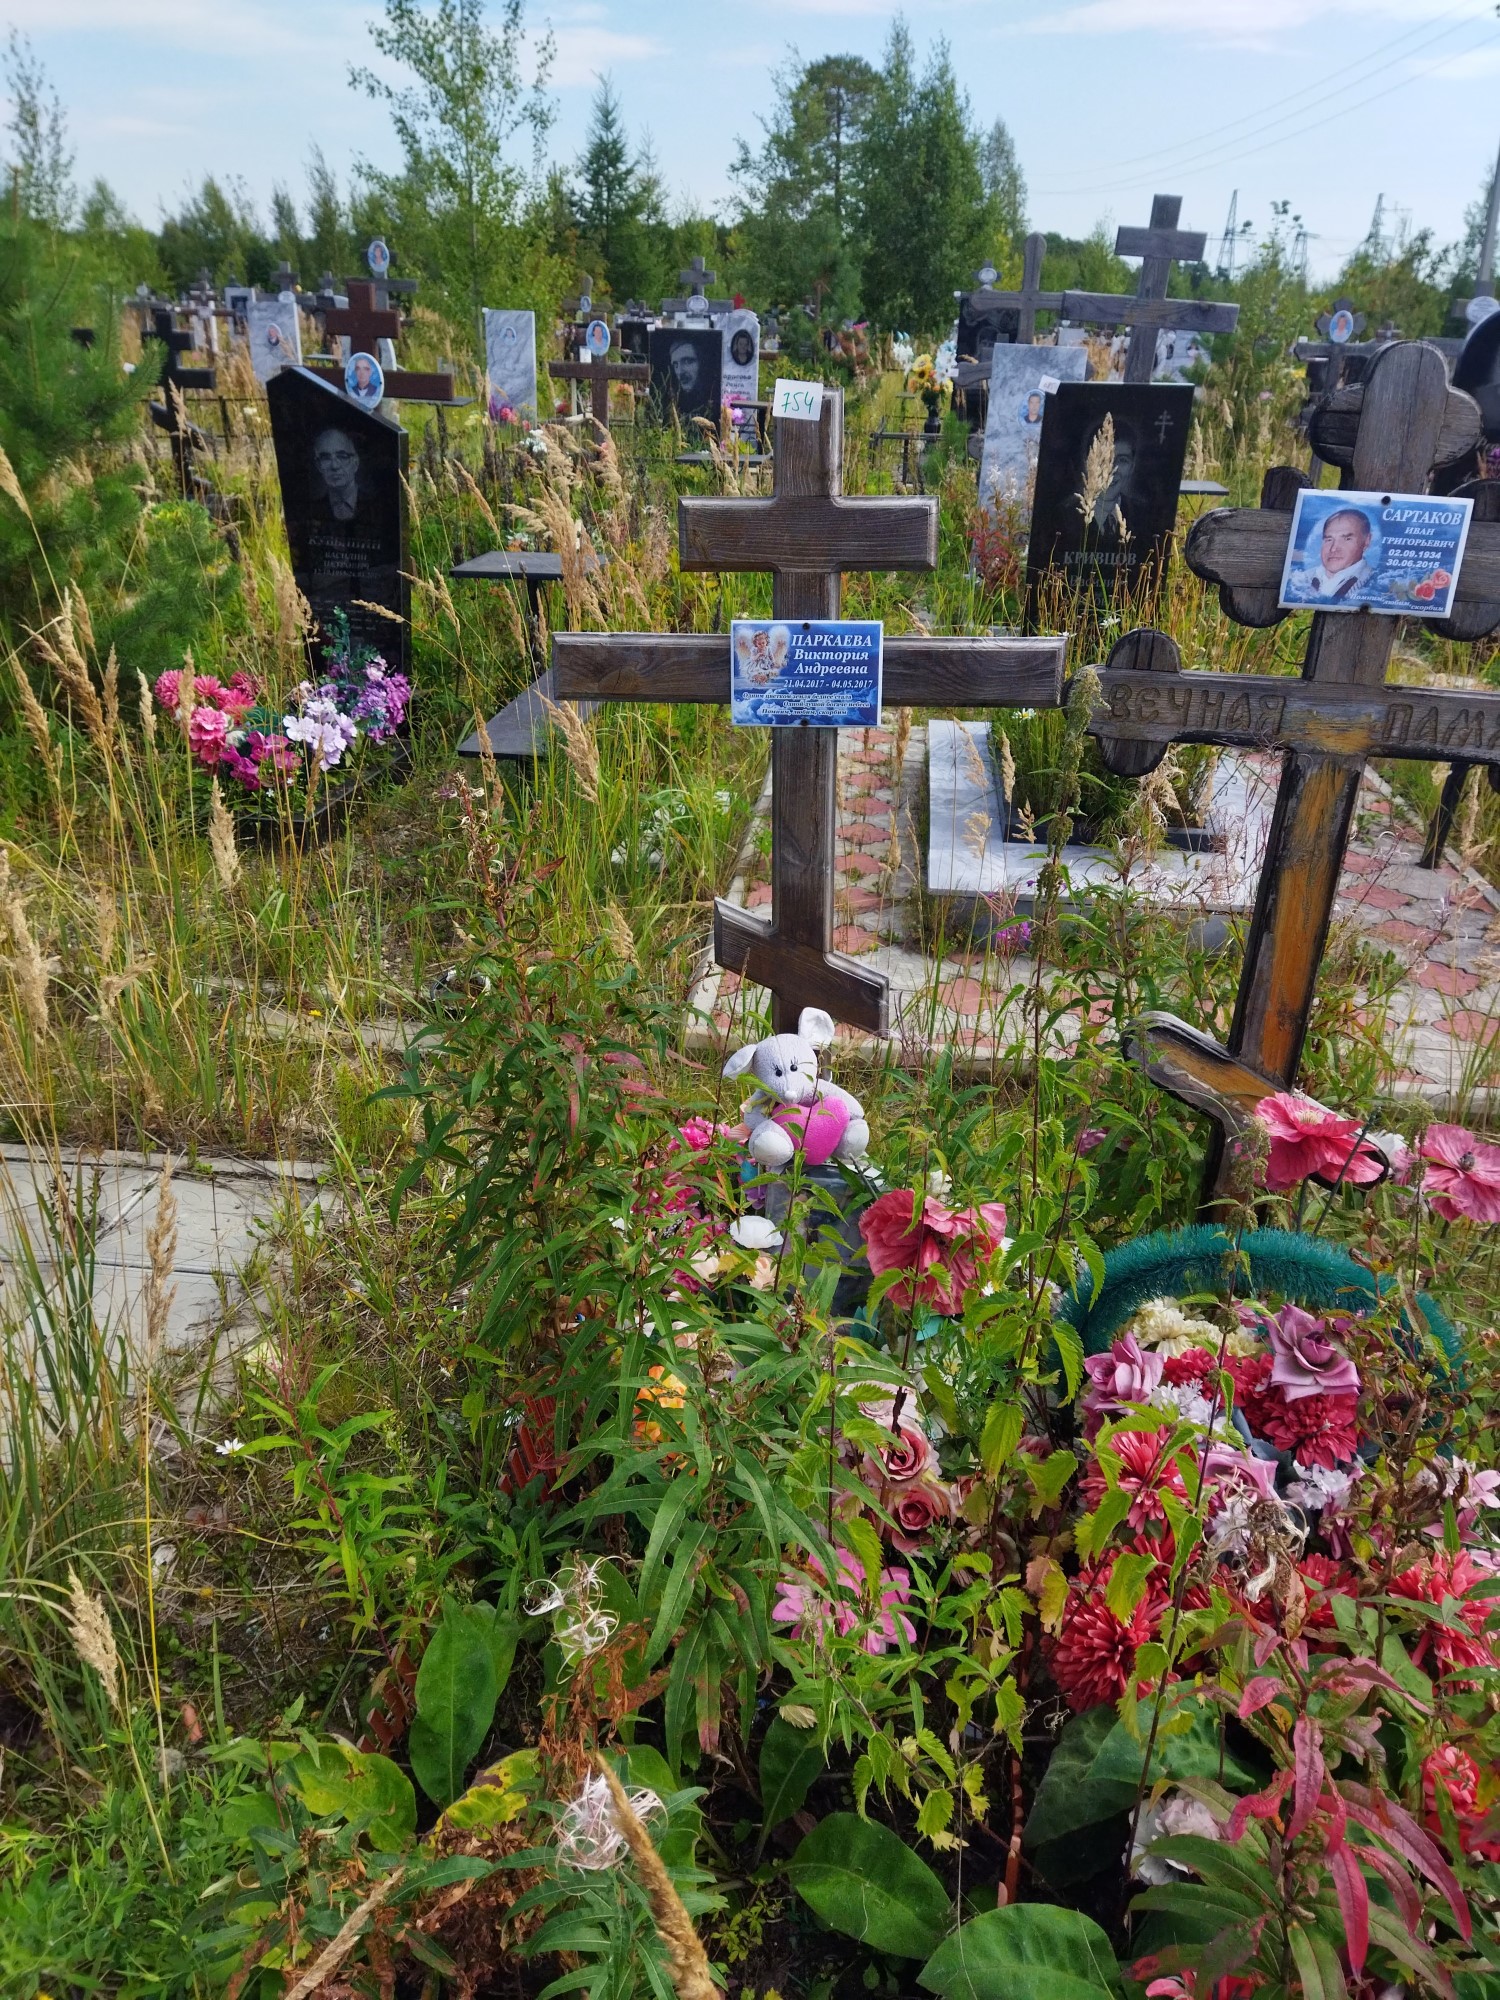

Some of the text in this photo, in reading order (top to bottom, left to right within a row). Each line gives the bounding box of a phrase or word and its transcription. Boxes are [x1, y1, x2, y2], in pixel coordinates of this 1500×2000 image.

[781, 391, 814, 414] 754
[1382, 508, 1462, 526] САРТАКОВ
[1404, 527, 1435, 536] ИВАН
[1381, 536, 1455, 549] ГРИГОРЬЕВИЧ
[1063, 551, 1138, 567] КРИВЦОВ
[1388, 549, 1442, 560] 02.09.1934
[1386, 558, 1440, 569] 30.06.2015
[1410, 604, 1444, 613] скорбим
[791, 634, 873, 647] ПАРКАЕВА
[793, 648, 869, 663] Виктория
[793, 662, 868, 676] Андреевна
[783, 679, 825, 689] 21.04.2017
[831, 679, 873, 689] 04.05.2017
[1107, 683, 1286, 736] ВЕЧНАЯ
